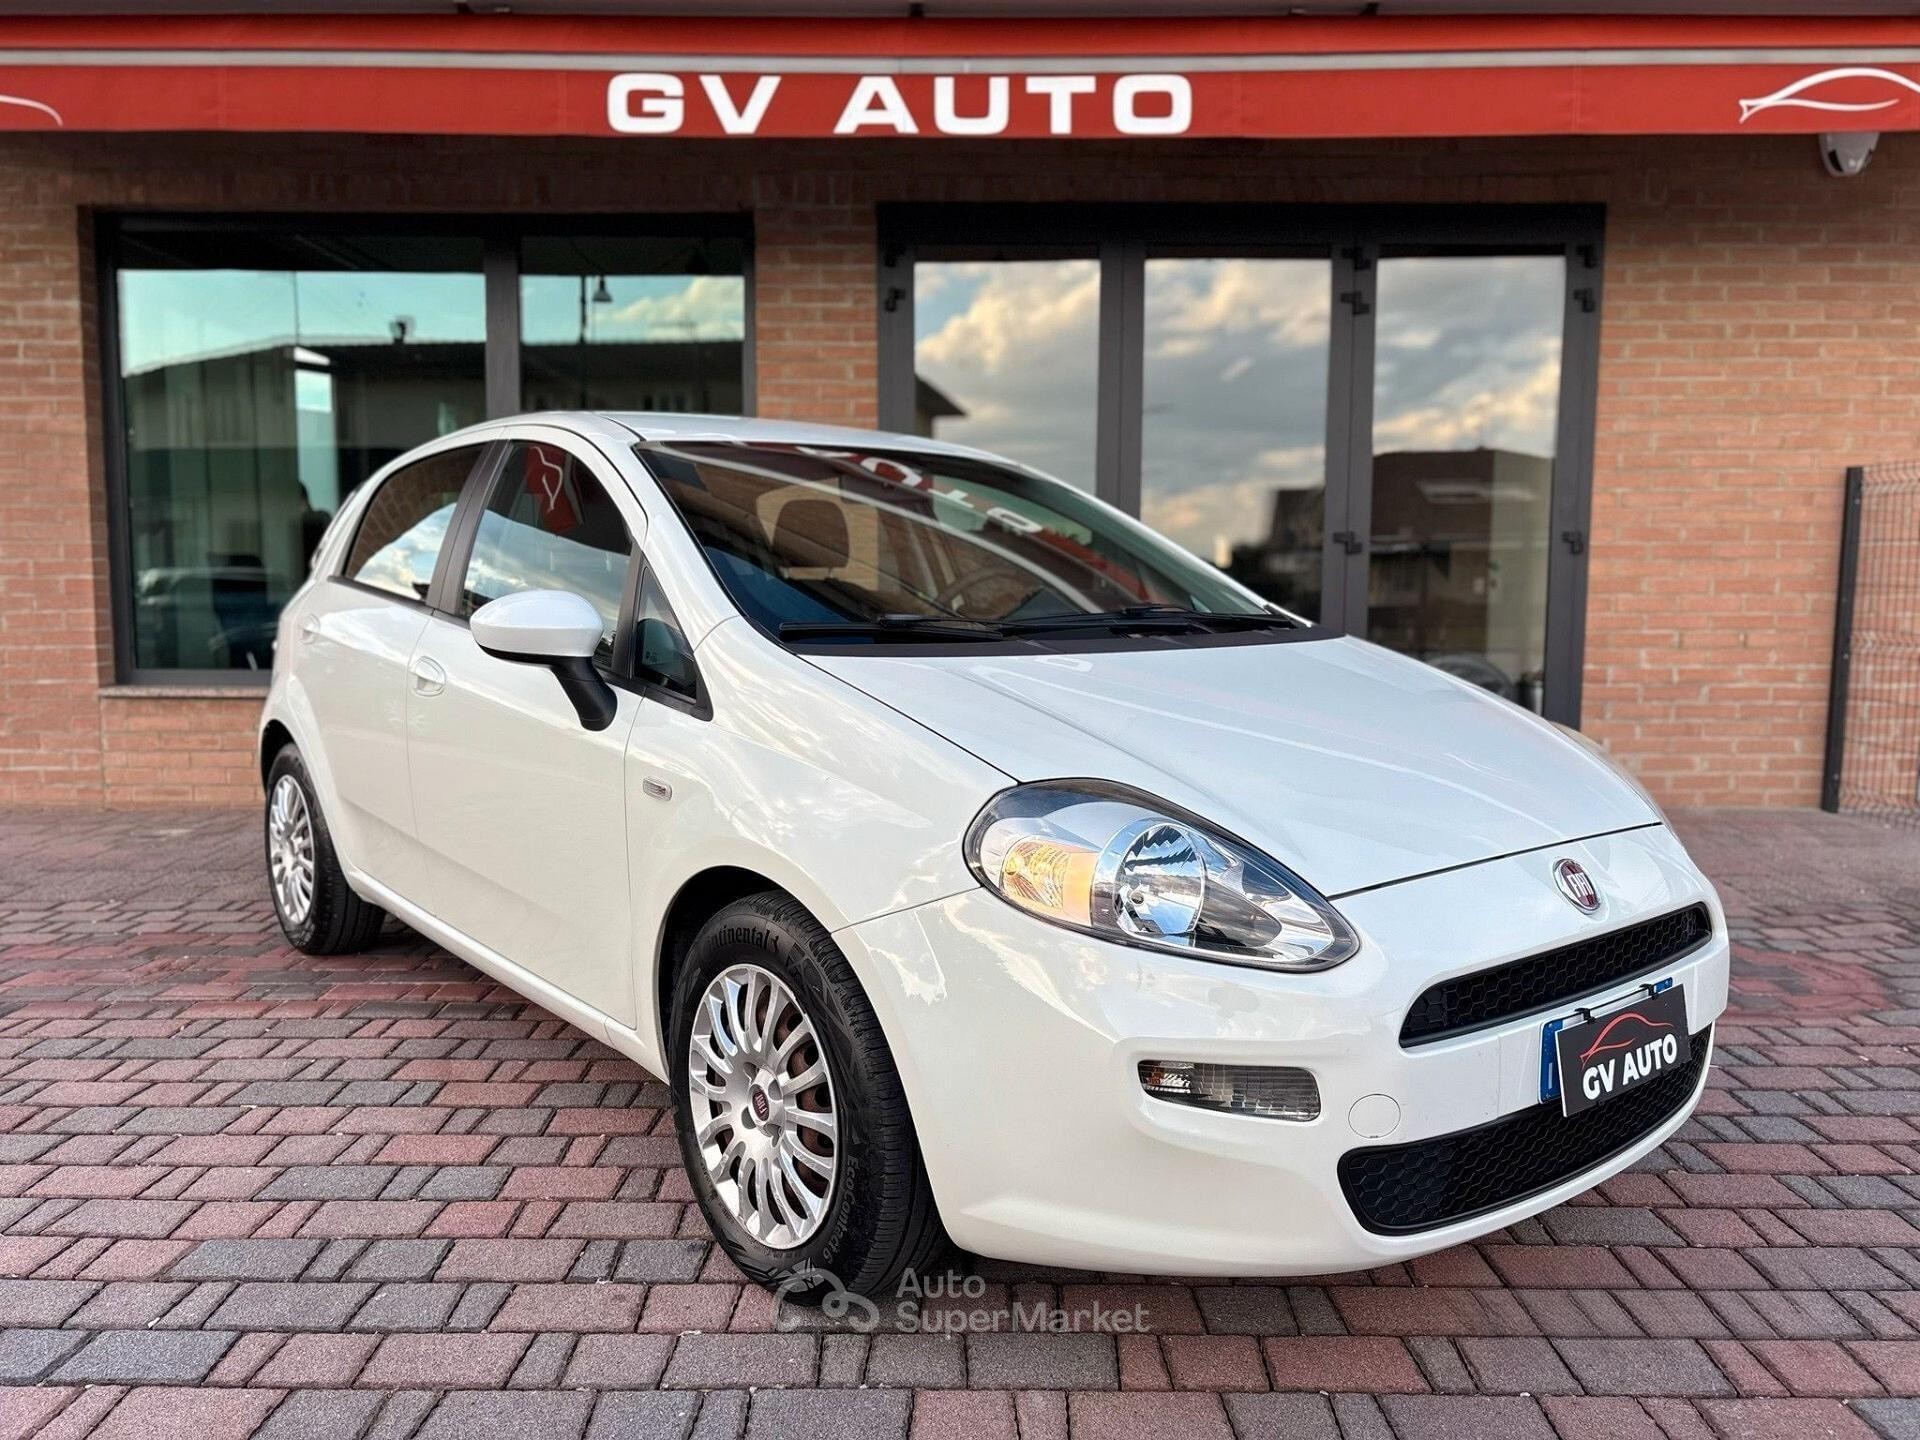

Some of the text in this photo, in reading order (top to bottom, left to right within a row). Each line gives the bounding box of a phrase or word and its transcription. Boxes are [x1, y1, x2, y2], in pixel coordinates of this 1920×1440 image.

[607, 73, 1193, 135] GV AUTO
[705, 925, 771, 953] ntinental
[1582, 1033, 1678, 1100] GV AUTO
